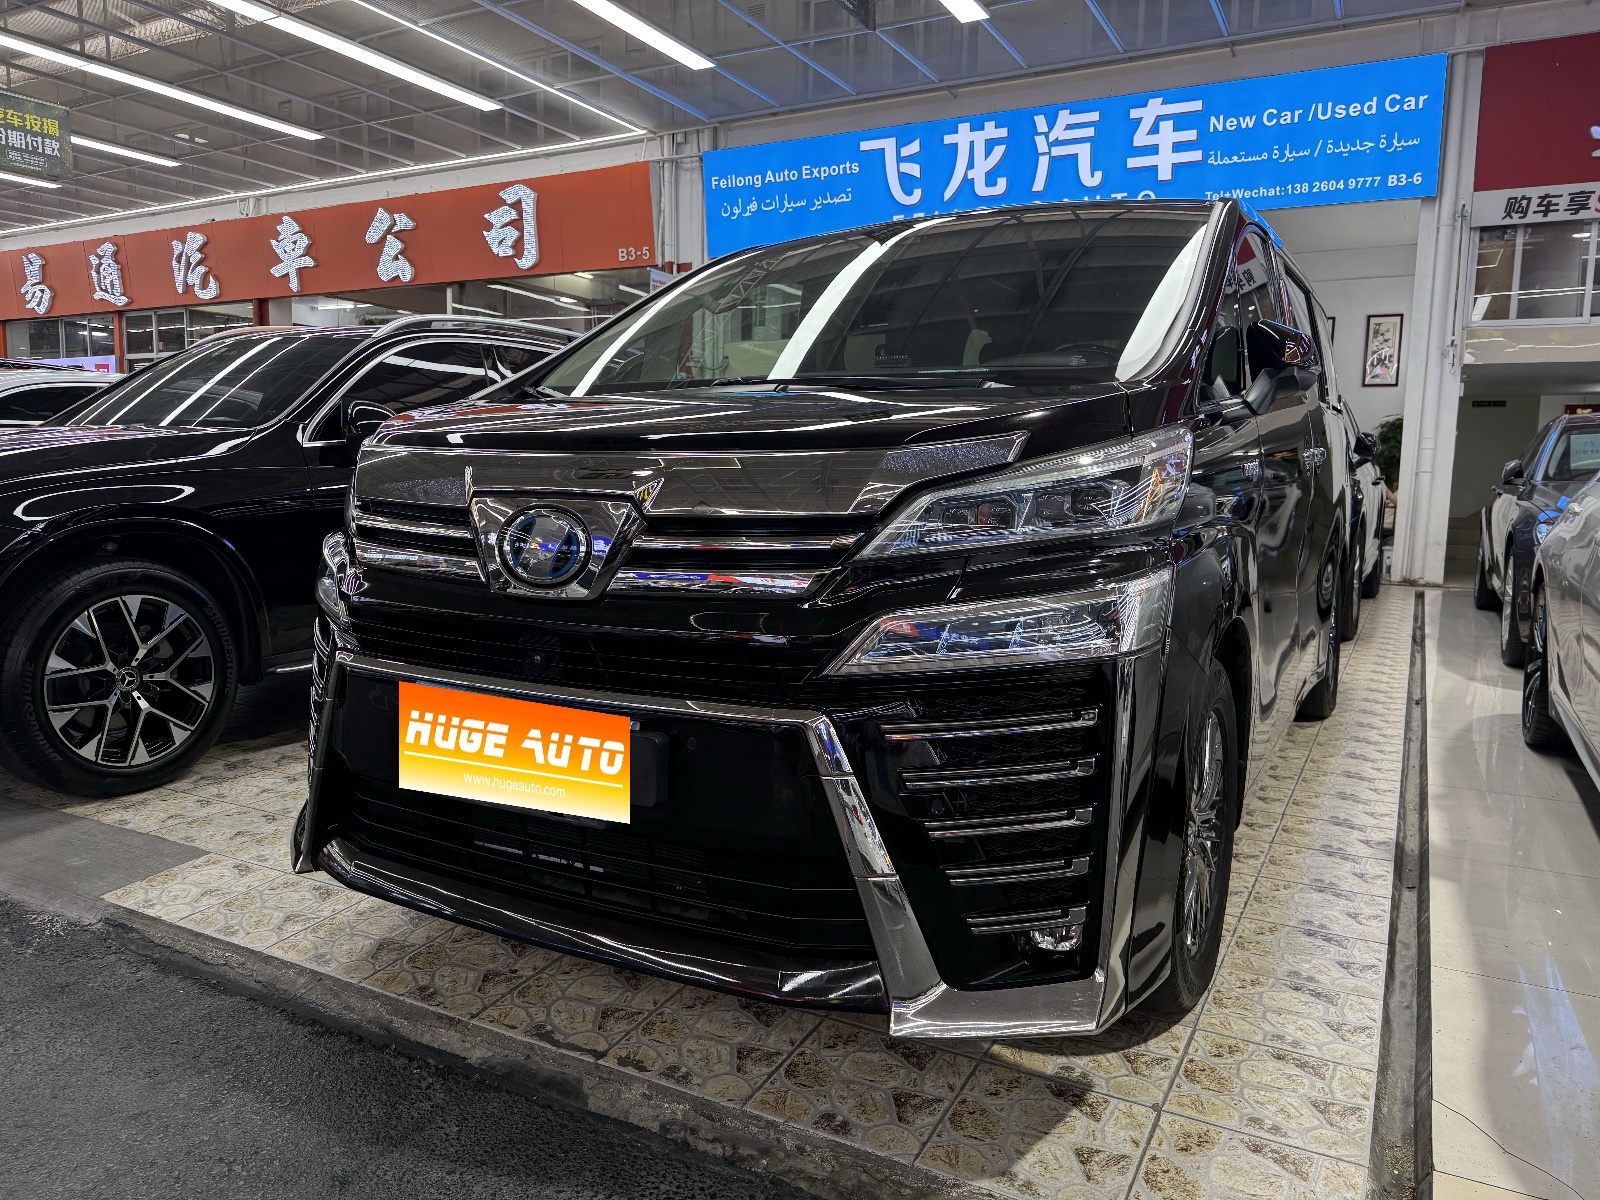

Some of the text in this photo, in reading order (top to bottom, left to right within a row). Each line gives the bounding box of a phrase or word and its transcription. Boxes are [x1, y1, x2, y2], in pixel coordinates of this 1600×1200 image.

[1209, 114, 1256, 133] New
[1262, 108, 1303, 127] Car
[1384, 93, 1429, 112] Car
[859, 98, 1204, 206] 飞龙汽车
[1207, 131, 1421, 166] سيارة جديدة / سيارة مستعملة
[711, 160, 860, 189] Feilong Auto Exports
[1312, 180, 1345, 193] 2604
[1348, 176, 1381, 190] 9777
[1387, 172, 1423, 187] B3-6
[760, 193, 807, 213] سيارات
[809, 187, 852, 211] تصدير
[1501, 190, 1600, 221] 购车享
[618, 246, 650, 262] B3-5
